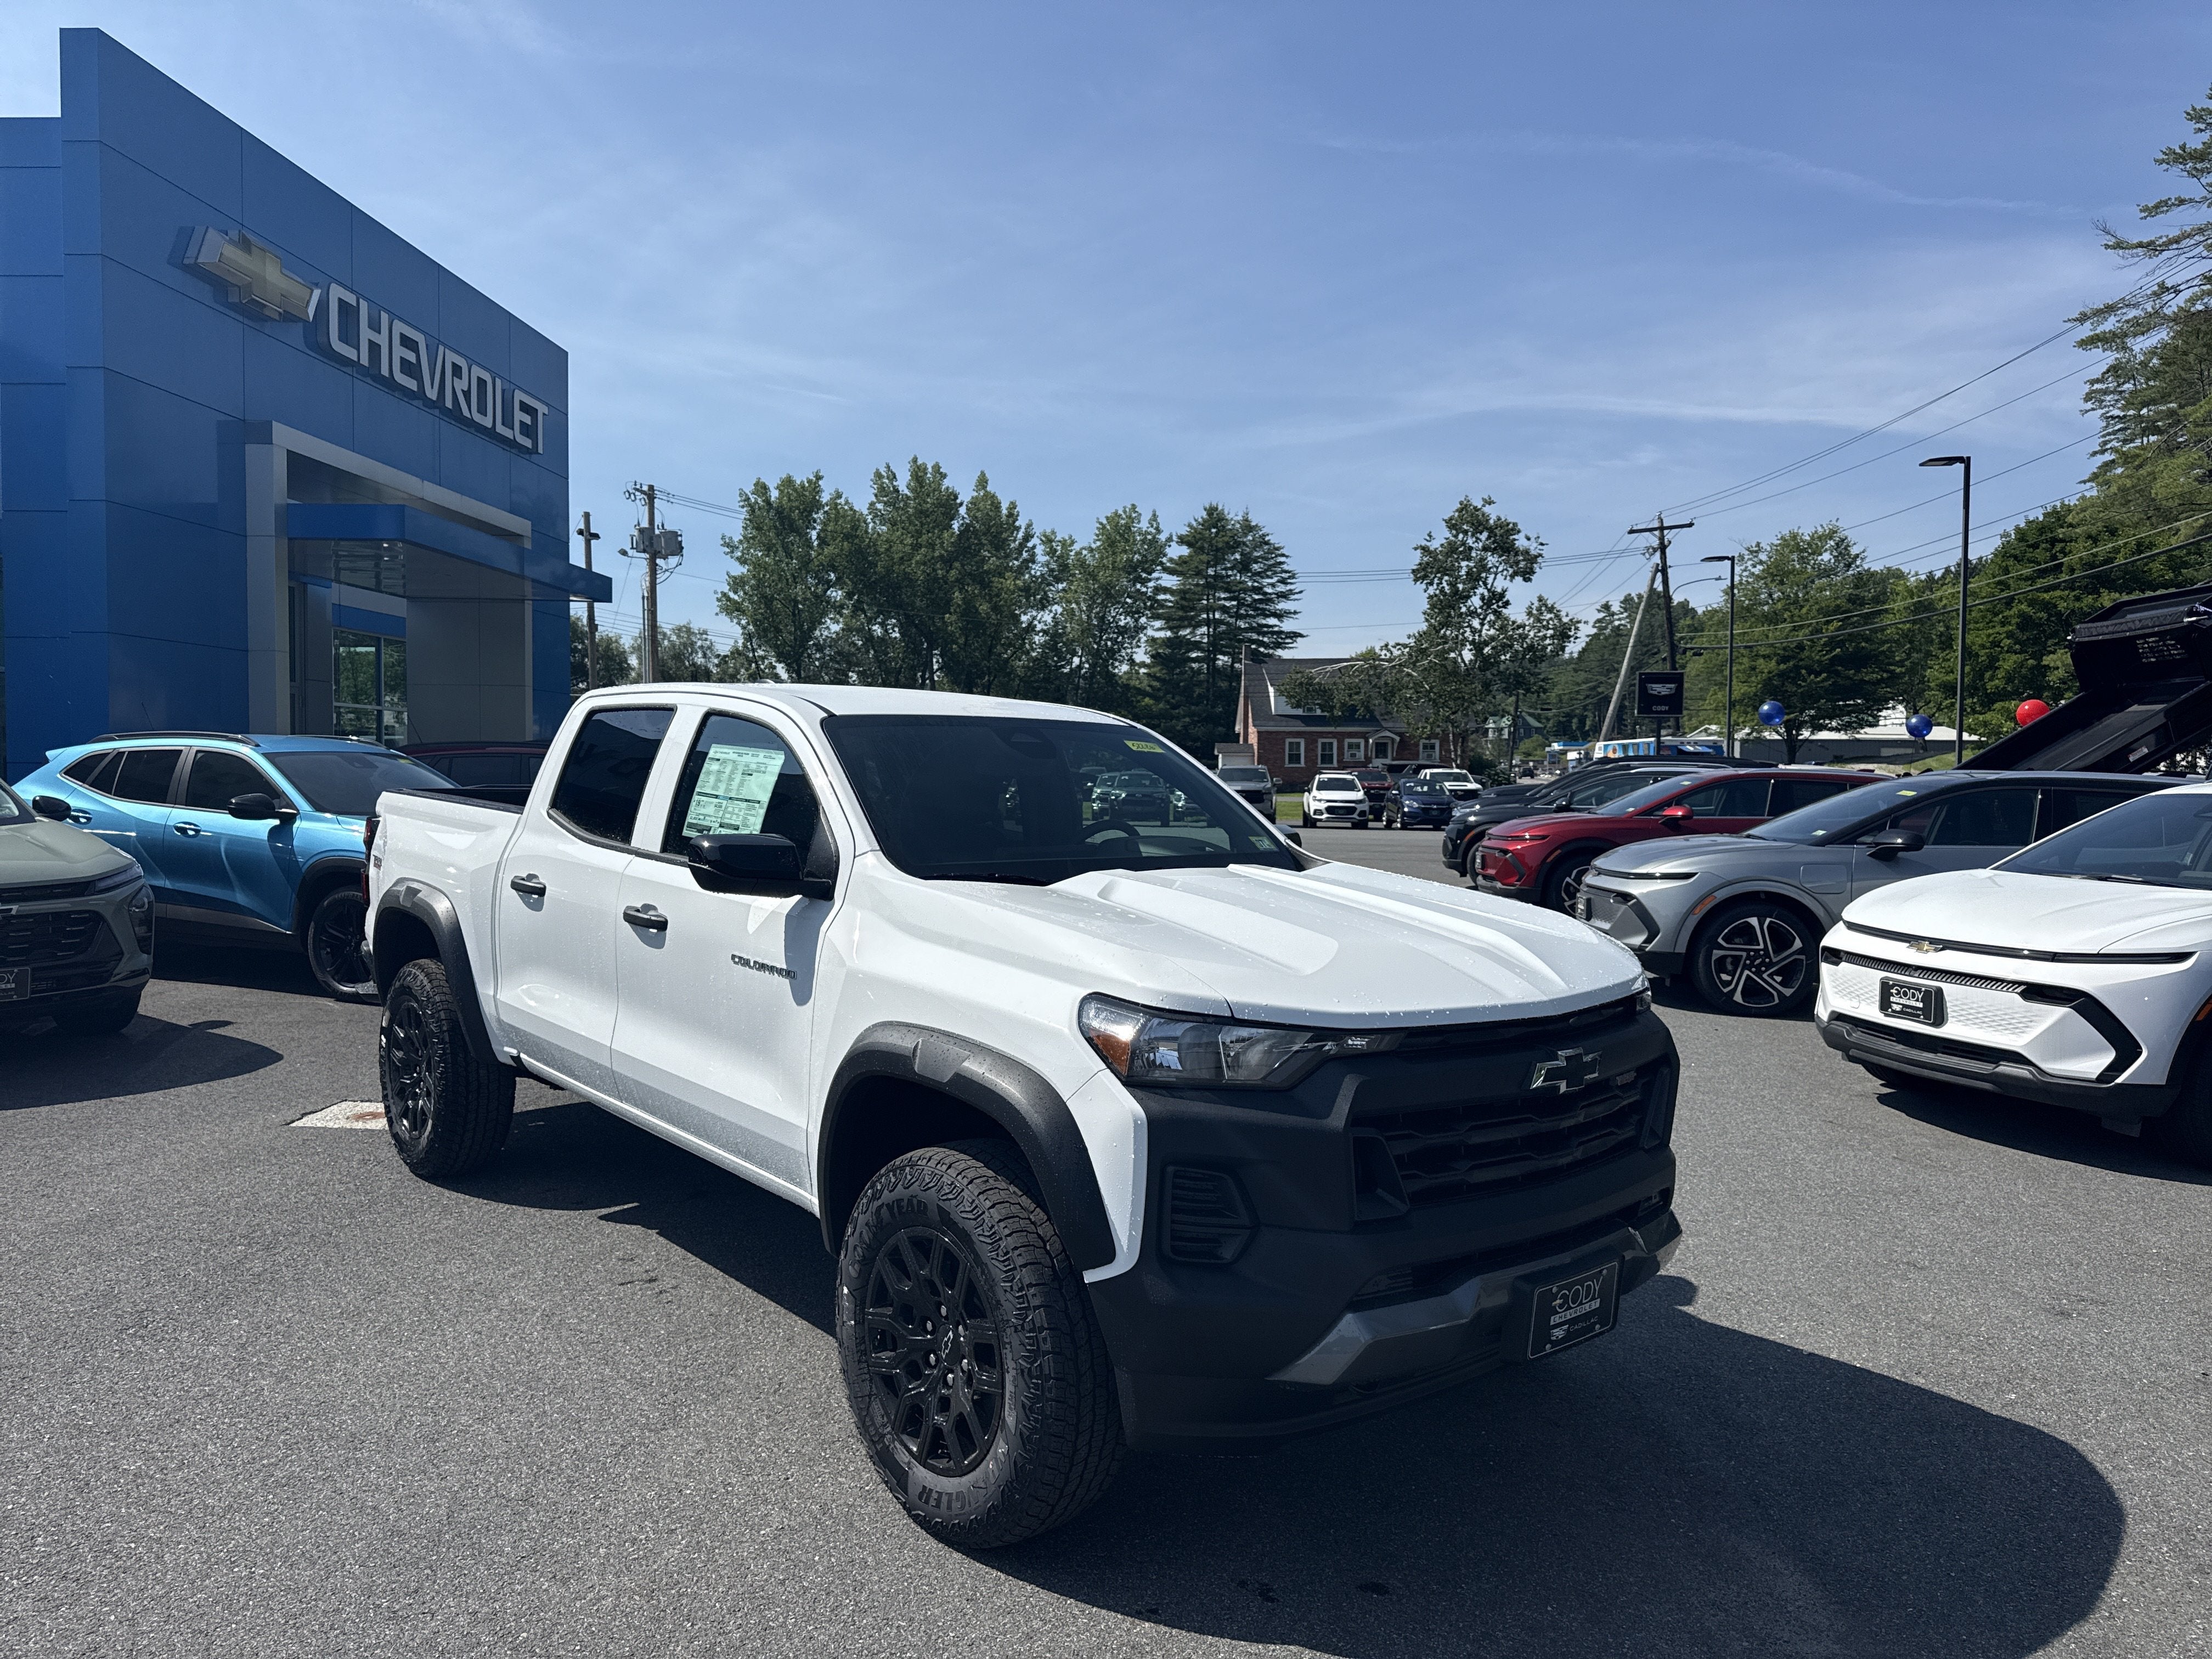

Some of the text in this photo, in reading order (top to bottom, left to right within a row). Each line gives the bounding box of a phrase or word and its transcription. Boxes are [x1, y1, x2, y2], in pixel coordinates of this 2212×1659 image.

[329, 282, 548, 454] CHEVROLET
[731, 953, 797, 979] COLORADO
[1893, 986, 1923, 1002] CODY
[1555, 1276, 1603, 1312] CODY
[1553, 1301, 1599, 1323] CHEVROLET
[1570, 1316, 1598, 1331] CADILLAC
